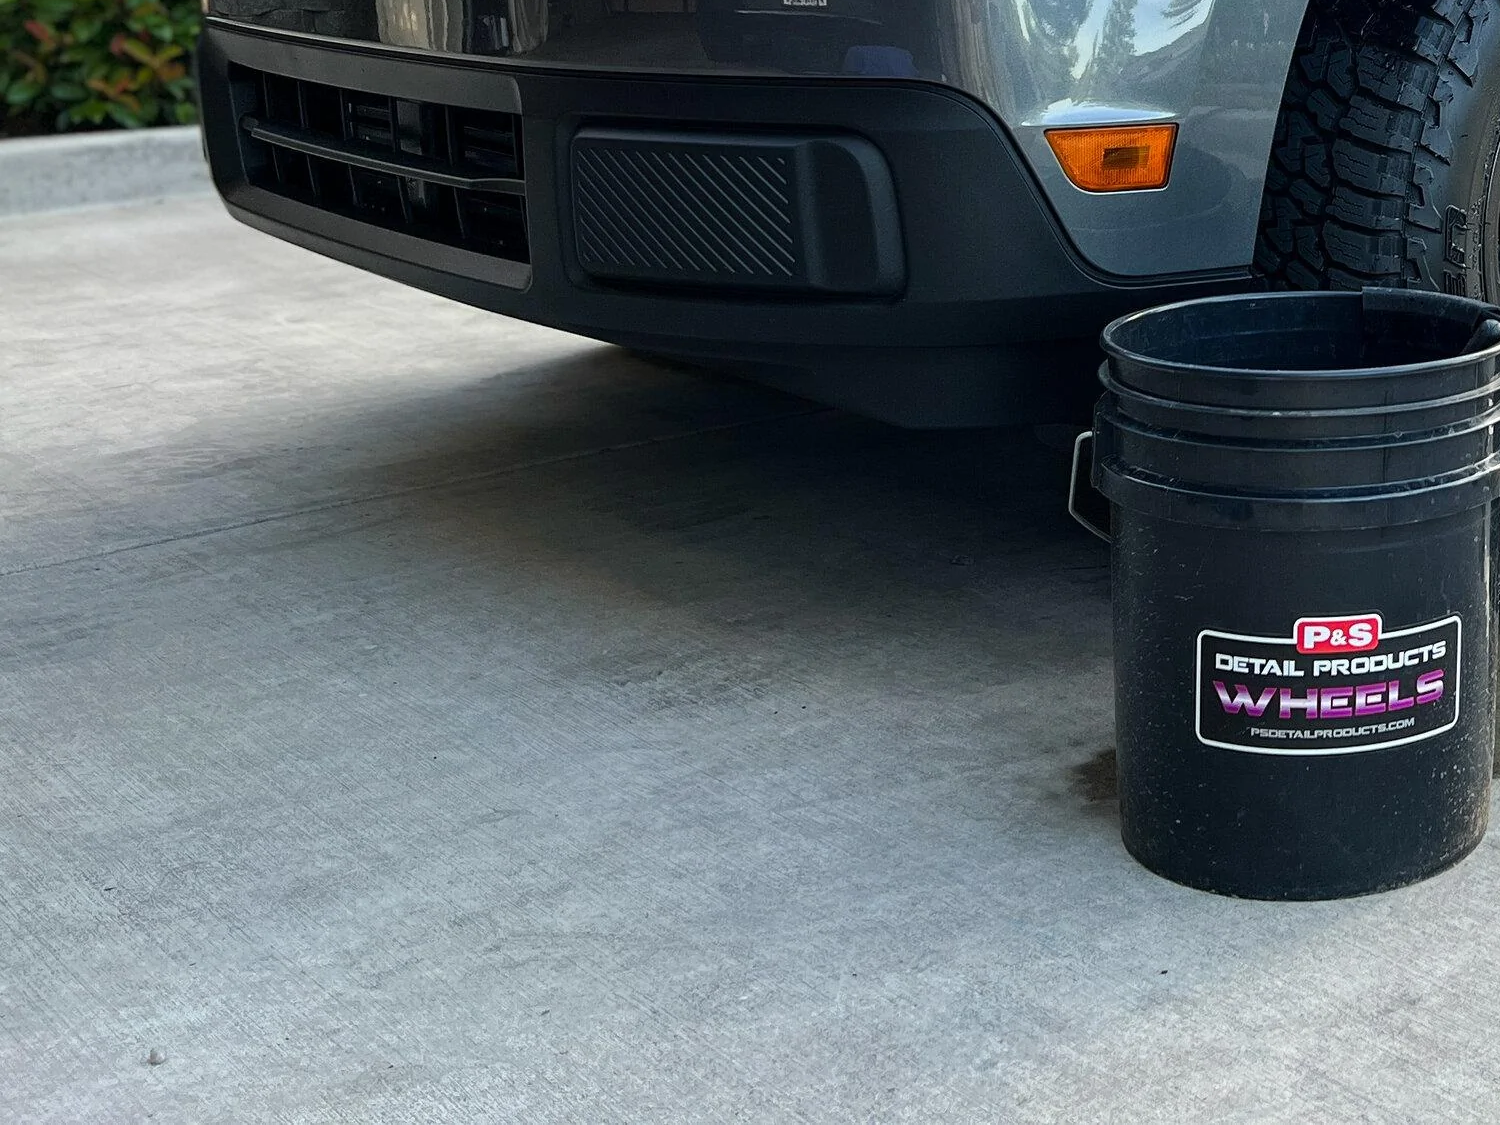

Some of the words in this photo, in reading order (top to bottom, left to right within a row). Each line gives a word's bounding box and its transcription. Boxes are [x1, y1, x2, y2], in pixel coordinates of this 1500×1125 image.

[1303, 623, 1373, 650] P&S
[1215, 653, 1304, 677] DETAIL
[1314, 640, 1446, 677] PRODUCTS
[1212, 668, 1445, 719] WHEELS
[1250, 718, 1415, 739] PSDETAILPRODUCTS.COM
